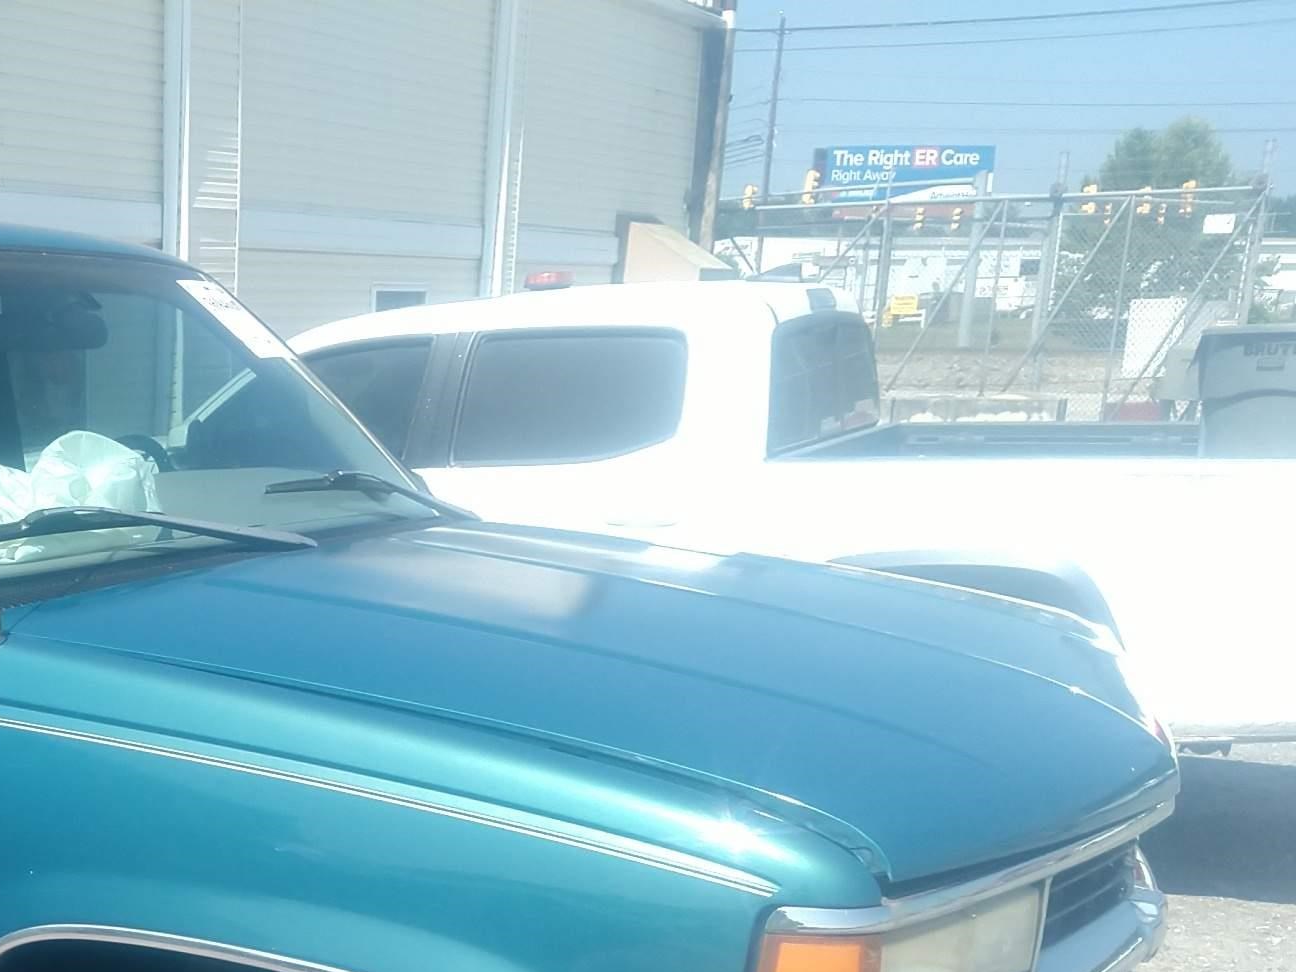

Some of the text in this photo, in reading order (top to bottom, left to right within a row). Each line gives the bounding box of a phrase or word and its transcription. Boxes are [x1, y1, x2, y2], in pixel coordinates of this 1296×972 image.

[833, 150, 980, 169] The Right ER Care
[831, 169, 896, 184] Right Away
[1244, 343, 1296, 356] BRUT
